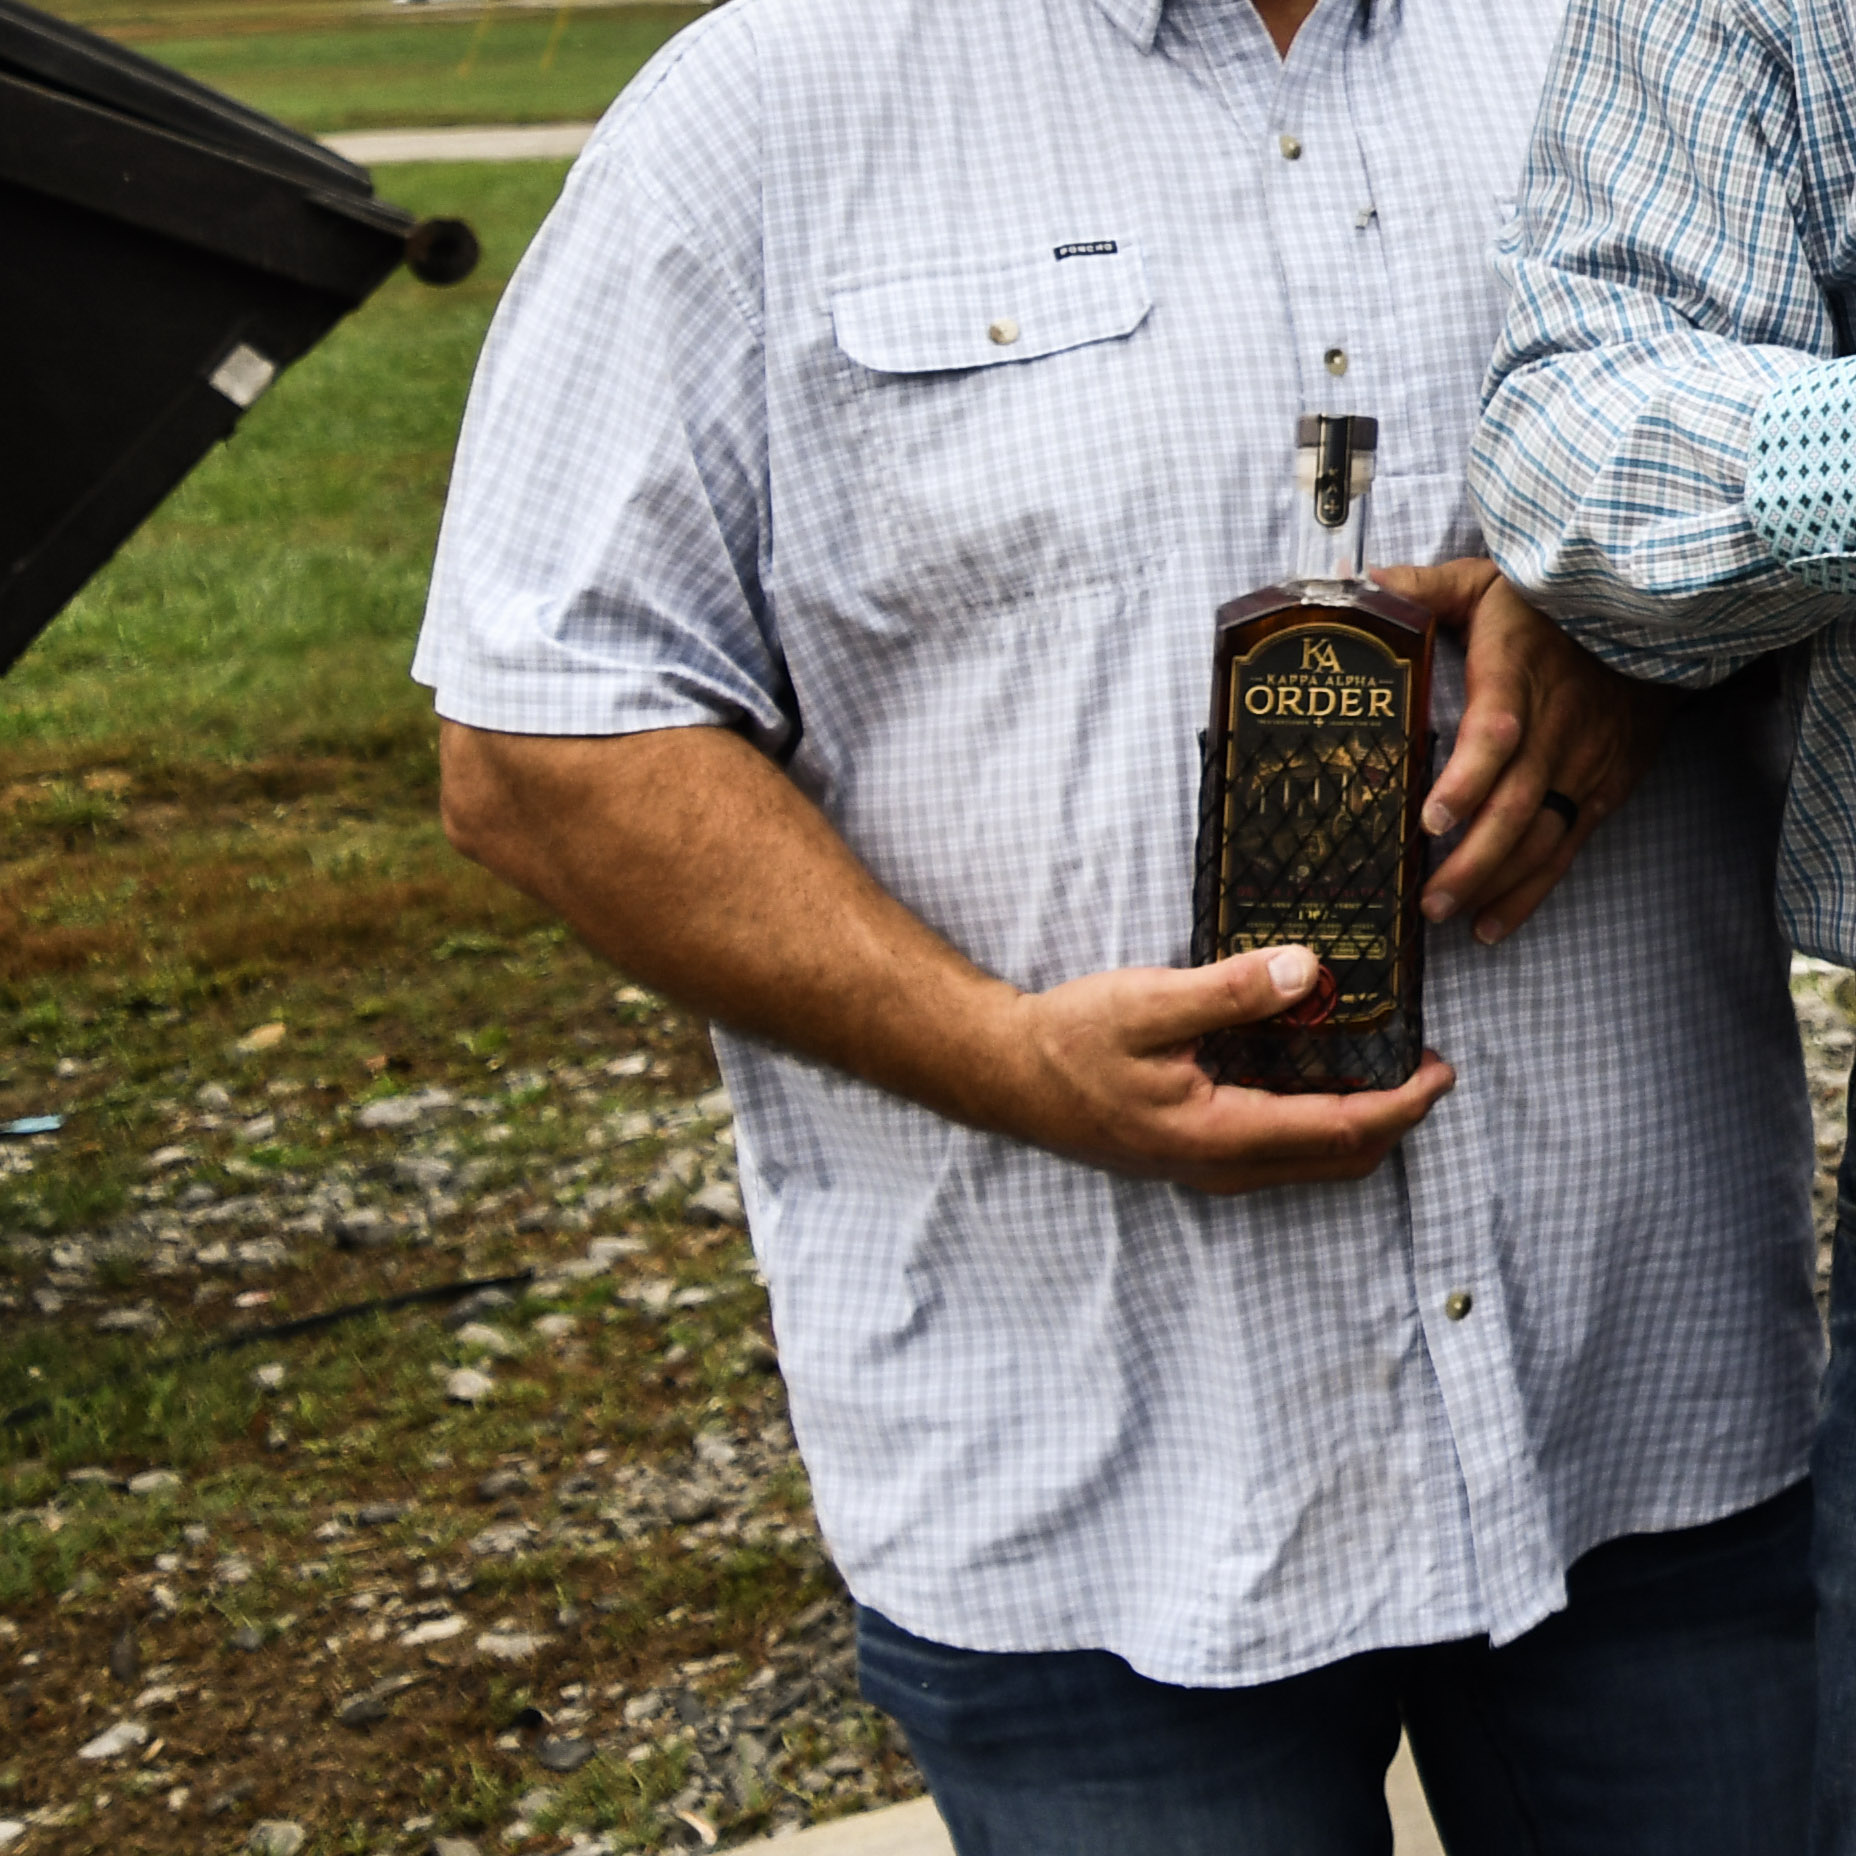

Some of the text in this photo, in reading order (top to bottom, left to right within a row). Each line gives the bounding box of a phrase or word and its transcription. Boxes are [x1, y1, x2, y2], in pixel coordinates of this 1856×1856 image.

[1300, 637, 1345, 674] KA
[1266, 673, 1378, 688] KAPPA ALPHA
[1244, 685, 1395, 717] ORDER
